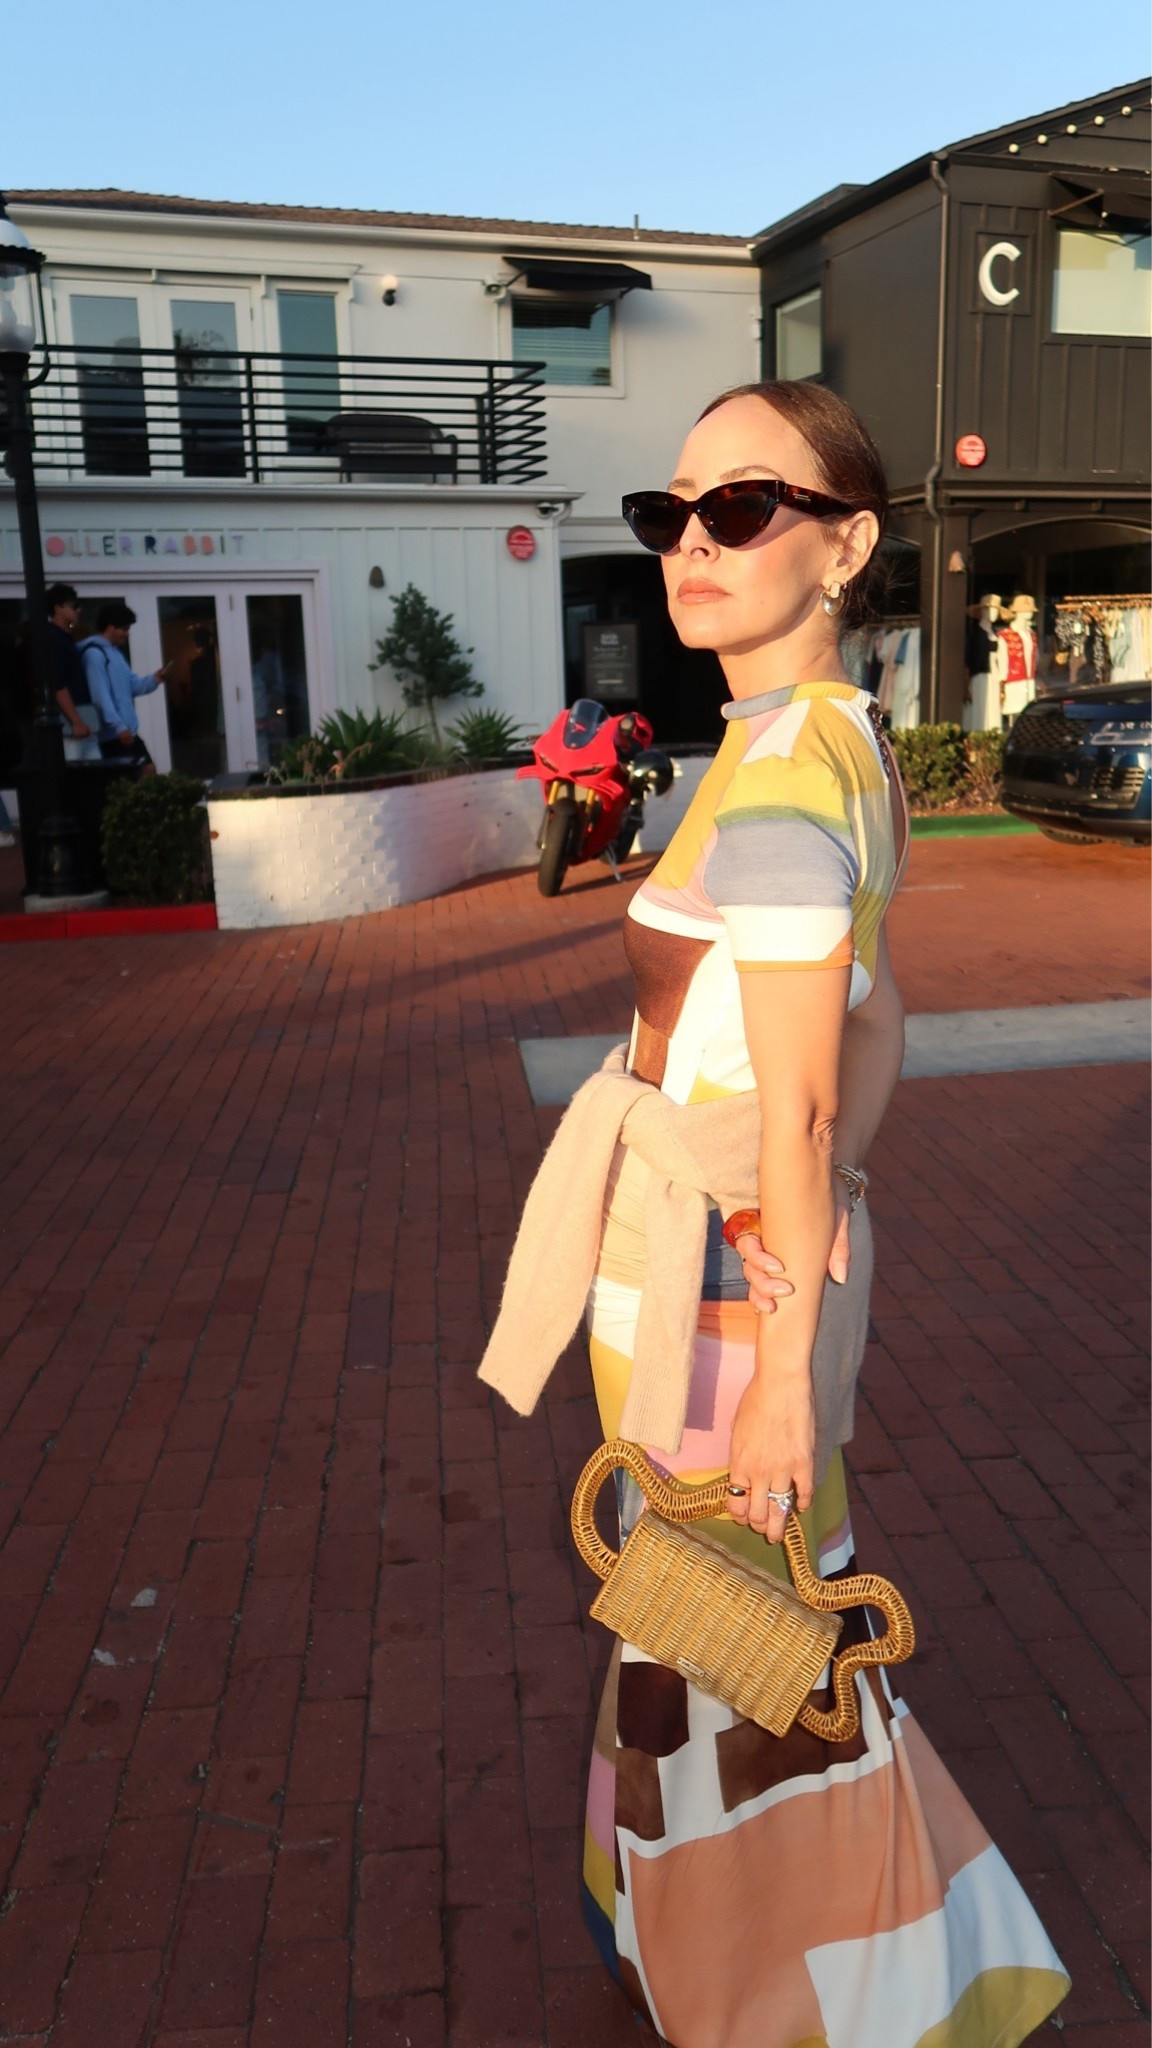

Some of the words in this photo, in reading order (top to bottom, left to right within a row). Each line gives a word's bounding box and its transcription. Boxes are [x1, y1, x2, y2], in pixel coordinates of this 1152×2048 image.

[978, 241, 1021, 306] C
[45, 534, 132, 557] OLLER
[144, 534, 244, 556] RABBIT
